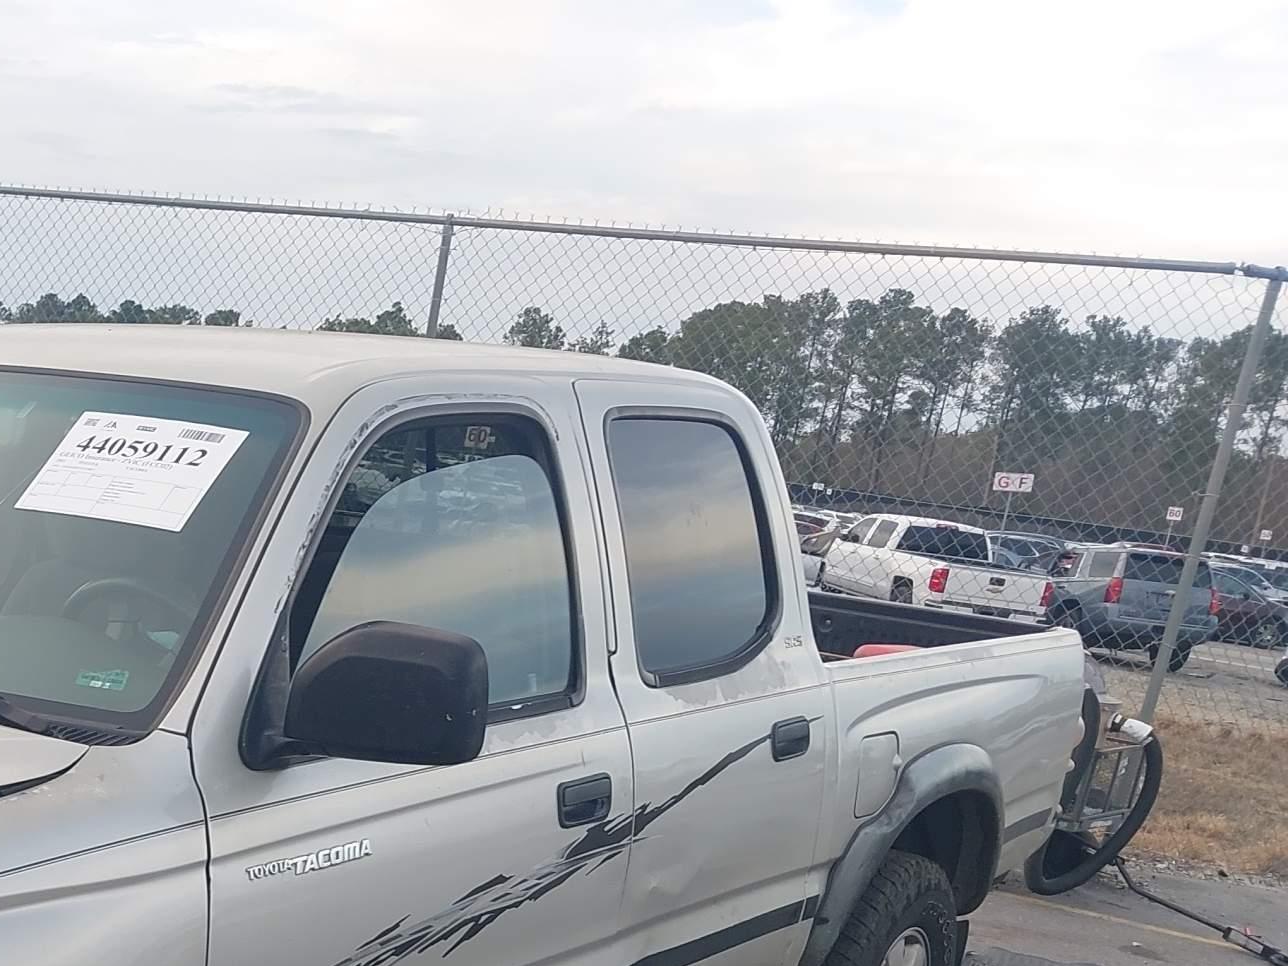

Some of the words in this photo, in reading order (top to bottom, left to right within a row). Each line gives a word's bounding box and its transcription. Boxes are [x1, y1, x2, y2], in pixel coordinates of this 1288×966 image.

[76, 435, 208, 467] 44059112
[246, 859, 292, 880] TOYOTA
[293, 839, 372, 875] TACOMA
